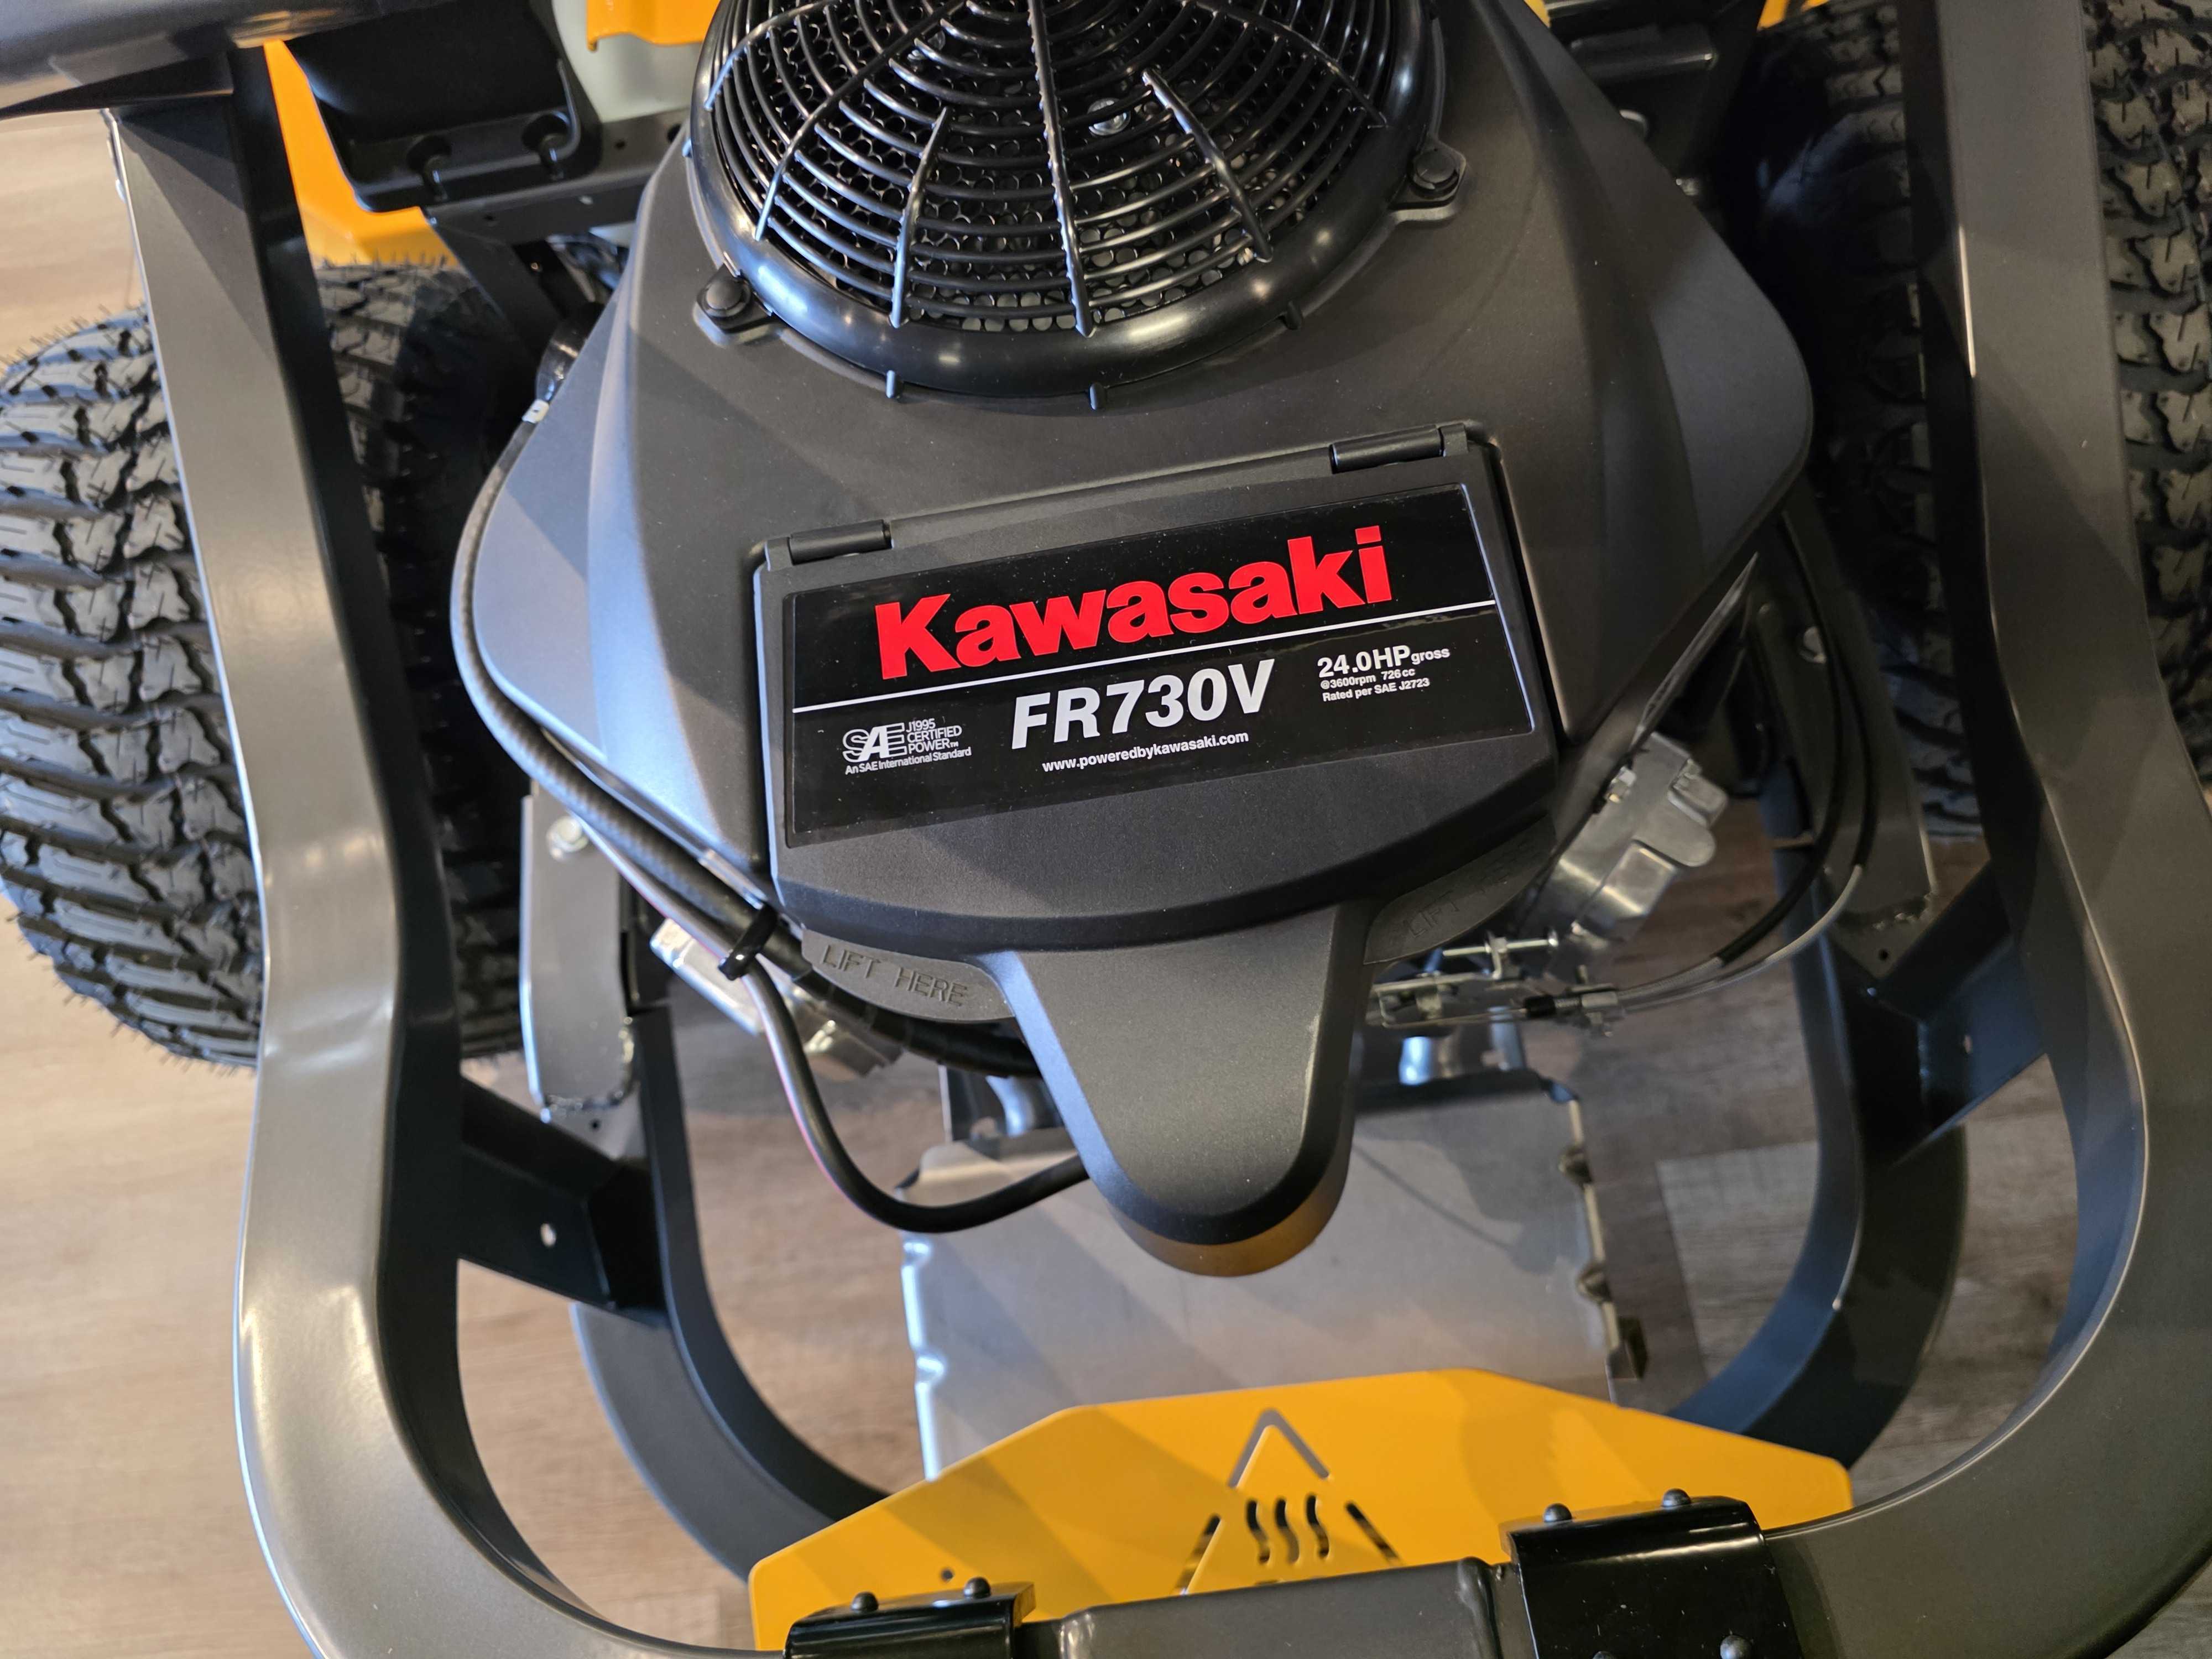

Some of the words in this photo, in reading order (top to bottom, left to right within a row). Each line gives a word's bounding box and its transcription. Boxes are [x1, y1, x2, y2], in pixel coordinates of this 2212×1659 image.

[875, 525, 1392, 680] Kawasaki
[1320, 674, 1376, 690] @3600rpm
[1381, 670, 1401, 680] 726
[1322, 689, 1353, 702] Rated
[1355, 687, 1373, 699] per
[1374, 682, 1397, 694] SAE
[1399, 677, 1430, 691] J2723
[1011, 659, 1275, 749] FR730V
[842, 722, 907, 763] SAE
[906, 718, 936, 733] J1995
[906, 725, 962, 743] CERTIFIED
[845, 765, 859, 775] An
[859, 761, 878, 773] SAE
[878, 755, 933, 770] International
[932, 746, 972, 761] Standard
[1042, 732, 1249, 773] www.poweredbykawasaki.com
[822, 945, 881, 979] LIFT
[895, 967, 968, 1007] HERE
